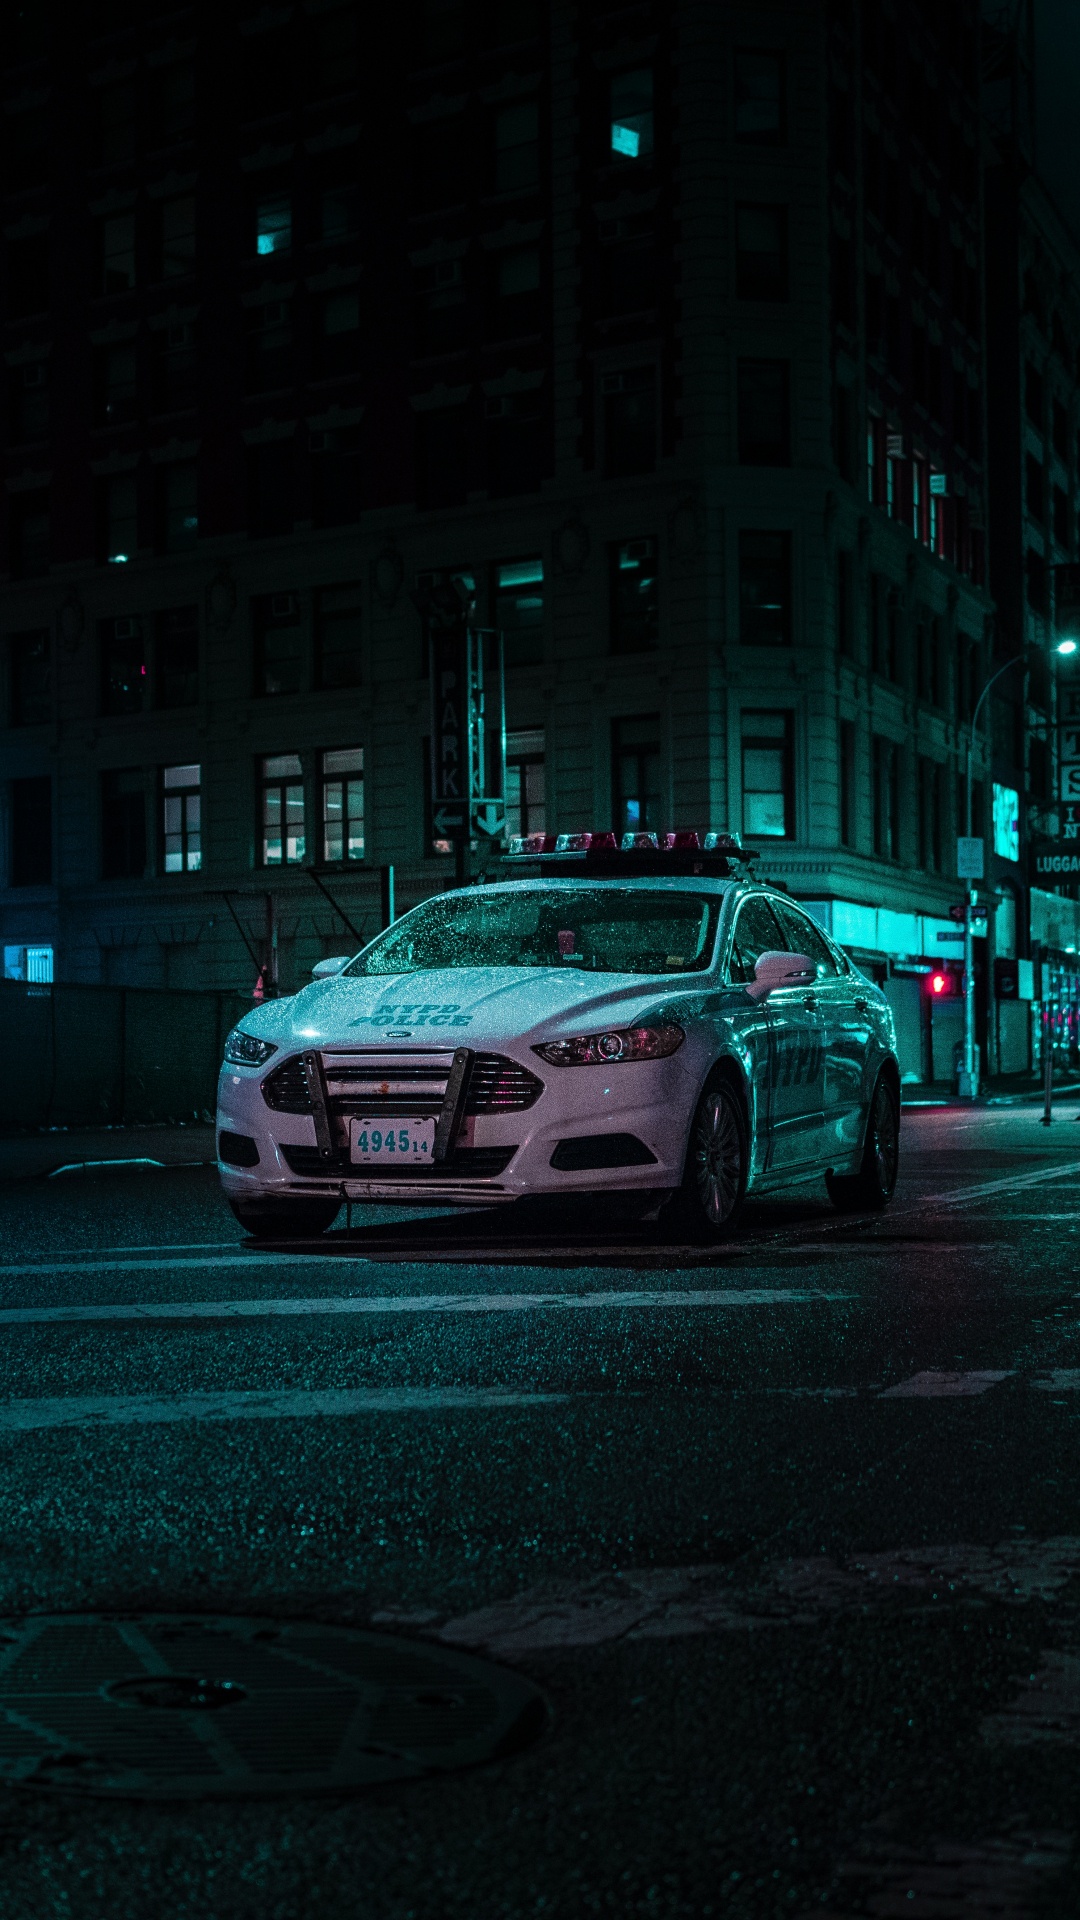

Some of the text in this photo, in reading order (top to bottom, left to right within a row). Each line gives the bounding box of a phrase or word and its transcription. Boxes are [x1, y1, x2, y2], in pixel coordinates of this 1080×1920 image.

[441, 671, 458, 797] PARK
[1036, 855, 1080, 873] LUGGA
[376, 1004, 461, 1014] NYPD
[347, 1015, 473, 1027] POLICE
[358, 1130, 427, 1152] 4945 14
